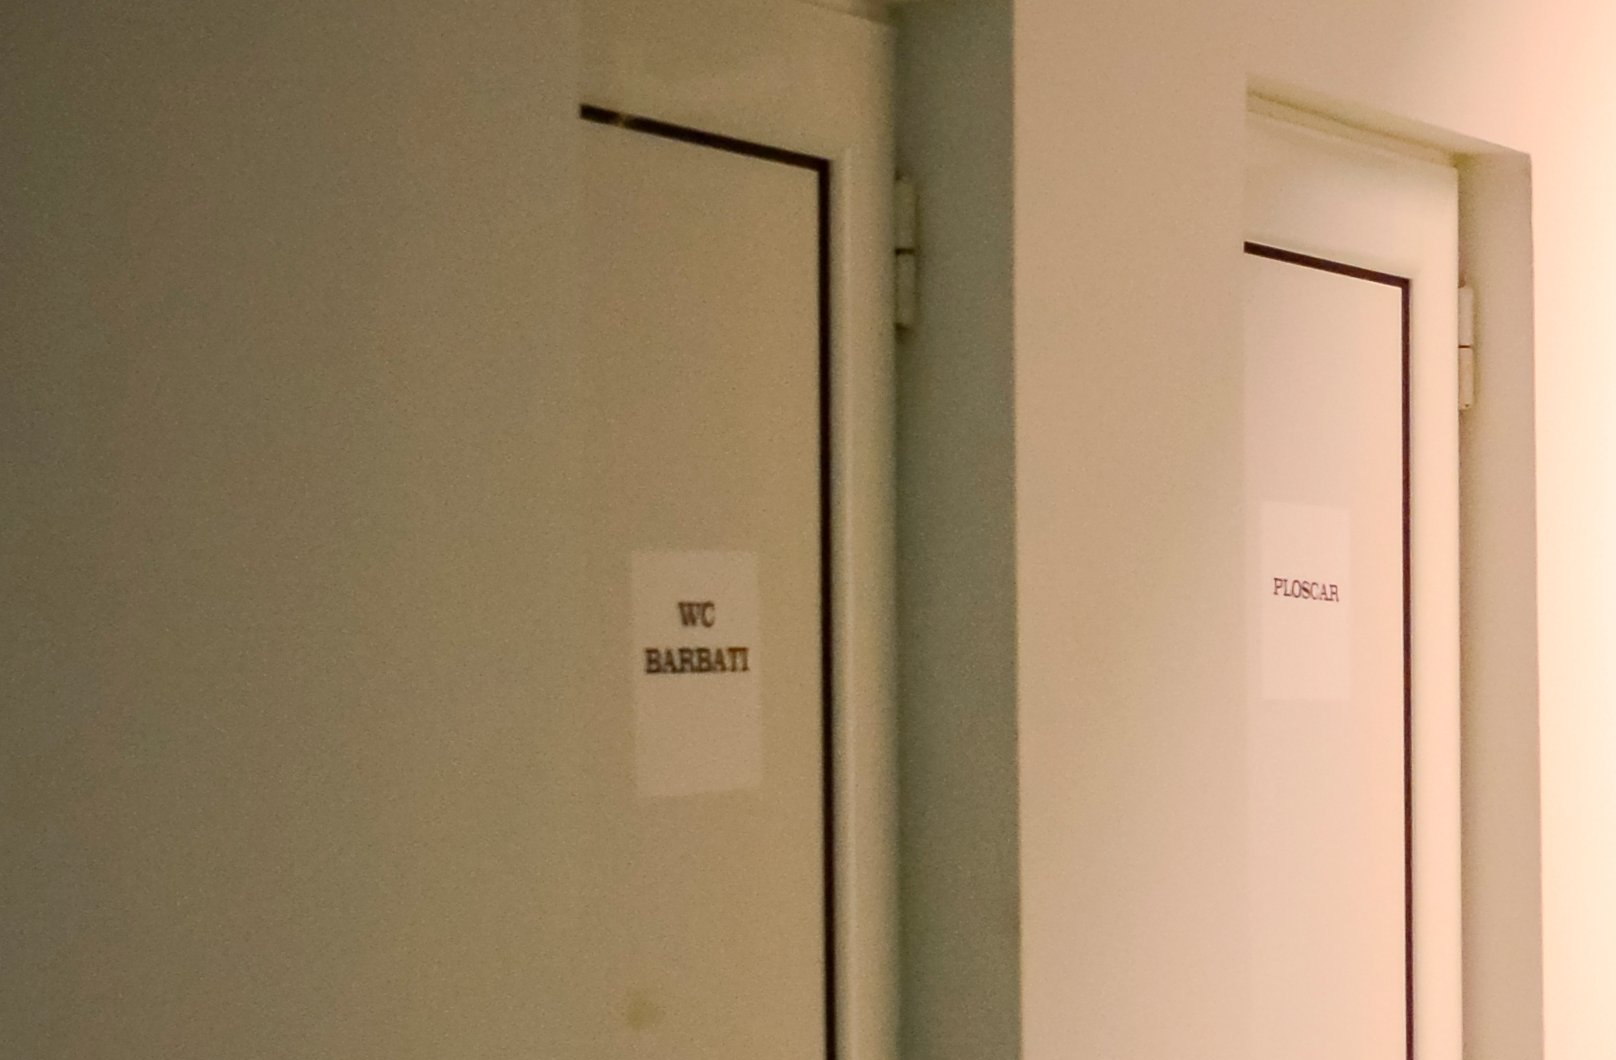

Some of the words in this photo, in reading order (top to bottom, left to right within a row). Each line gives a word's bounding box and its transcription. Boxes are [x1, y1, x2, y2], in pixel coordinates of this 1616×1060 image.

[1273, 577, 1339, 602] PLOSCAR
[678, 601, 715, 628] WC
[644, 646, 750, 674] BARBATI
